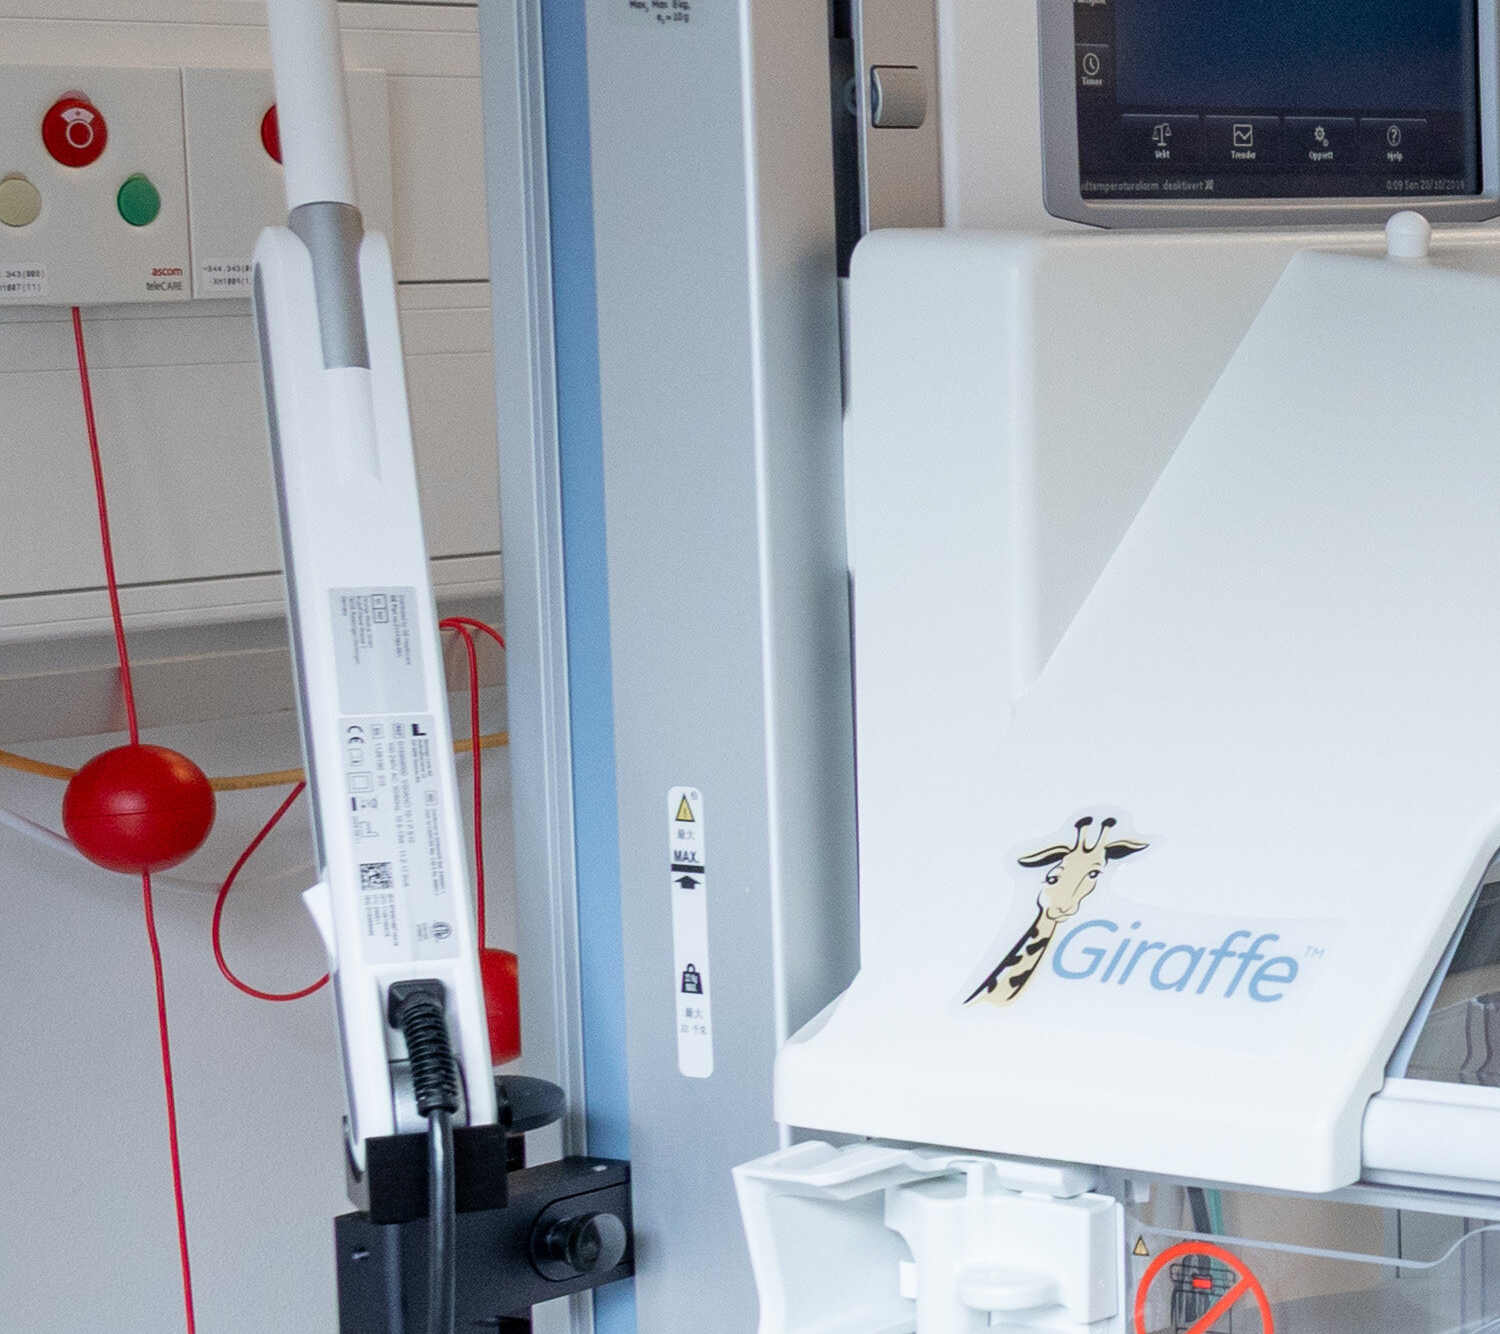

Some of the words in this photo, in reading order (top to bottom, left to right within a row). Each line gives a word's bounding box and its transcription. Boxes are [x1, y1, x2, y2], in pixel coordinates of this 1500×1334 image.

[152, 268, 183, 276] ascom
[146, 281, 183, 291] teleCARE
[673, 850, 699, 863] MAX.
[1051, 918, 1299, 1004] Giraffe
